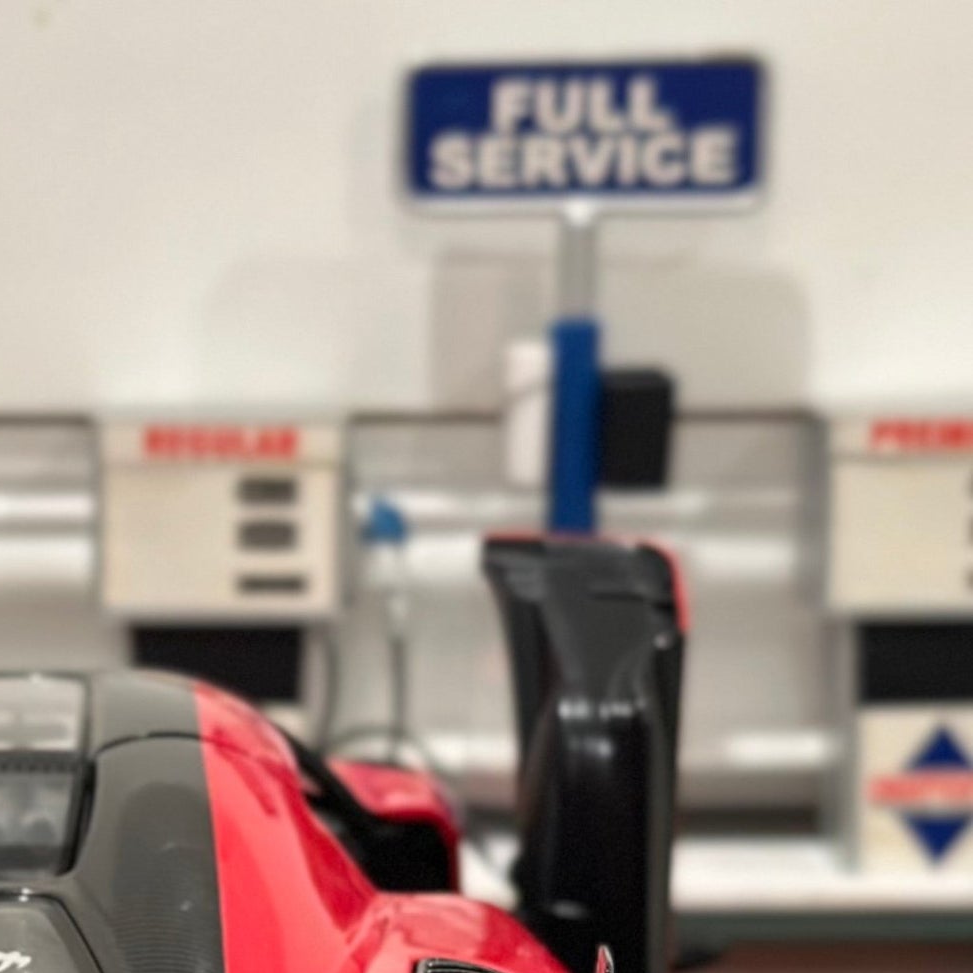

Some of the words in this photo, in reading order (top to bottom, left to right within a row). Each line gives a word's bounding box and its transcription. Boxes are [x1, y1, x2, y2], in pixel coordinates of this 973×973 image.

[490, 76, 673, 134] FULL
[430, 128, 739, 189] SERVICE
[143, 424, 298, 461] REGULAR
